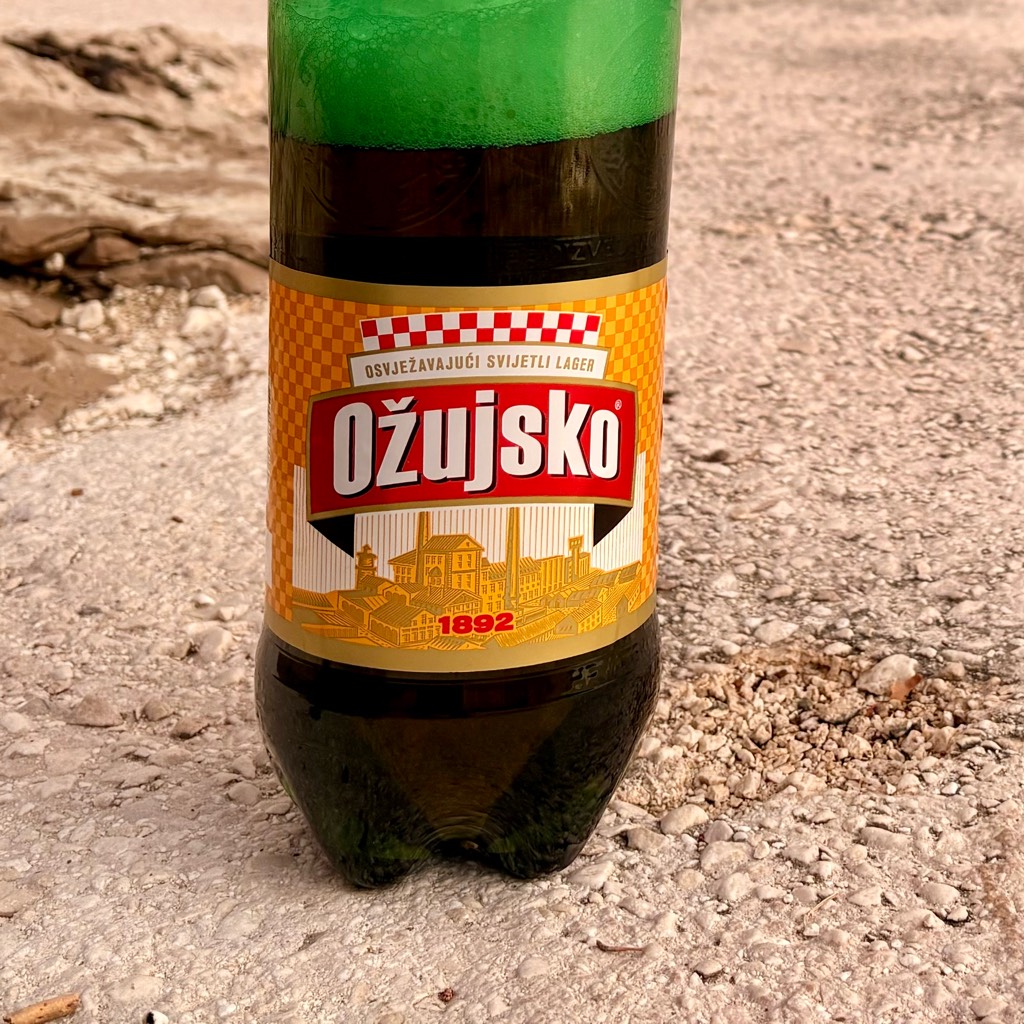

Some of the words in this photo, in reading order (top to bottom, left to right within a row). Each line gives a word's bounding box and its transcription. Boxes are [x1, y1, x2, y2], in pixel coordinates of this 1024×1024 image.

[364, 352, 480, 379] OSVJEŽAVAJUĆI
[486, 354, 550, 369] SVIJETLI
[555, 356, 595, 373] LAGER
[333, 389, 620, 496] Ožujsko
[437, 612, 515, 635] 1892
